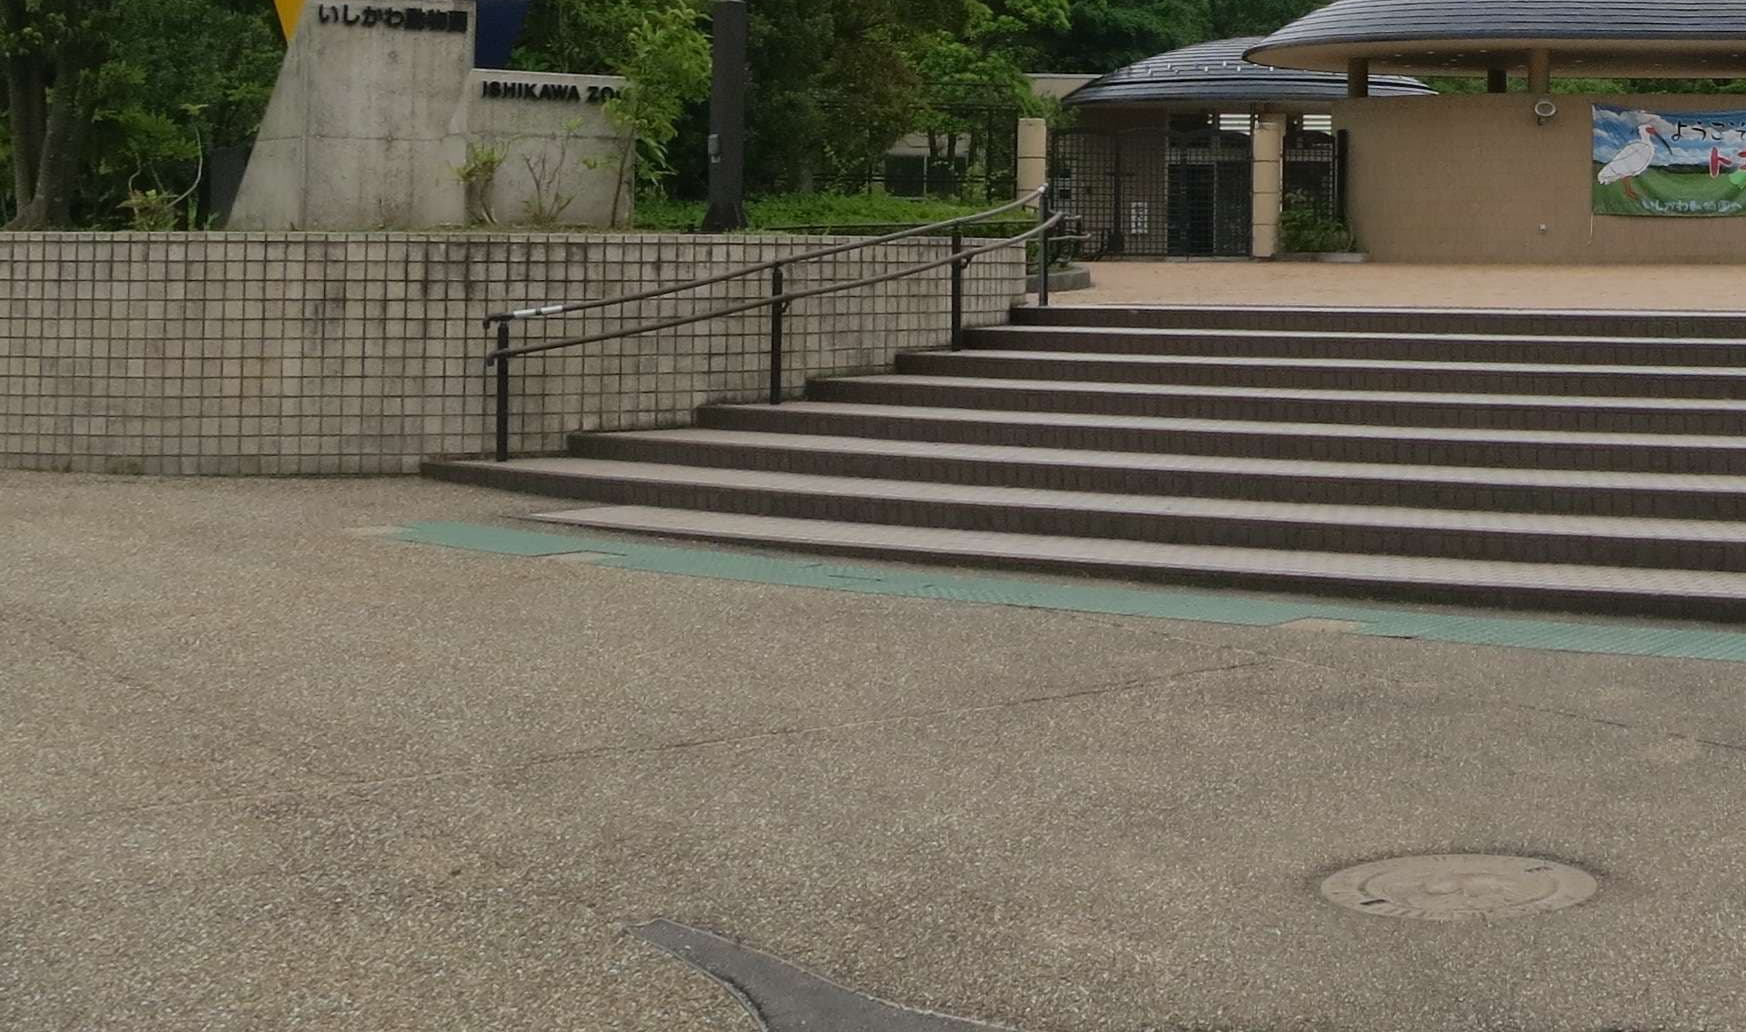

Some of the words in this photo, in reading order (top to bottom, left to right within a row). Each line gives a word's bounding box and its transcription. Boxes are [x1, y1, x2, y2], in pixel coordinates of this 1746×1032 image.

[319, 4, 468, 32] いしかわ動物園
[482, 81, 580, 101] ISHIKAWA
[586, 86, 621, 102] ZO
[1671, 120, 1746, 142] ようこそ
